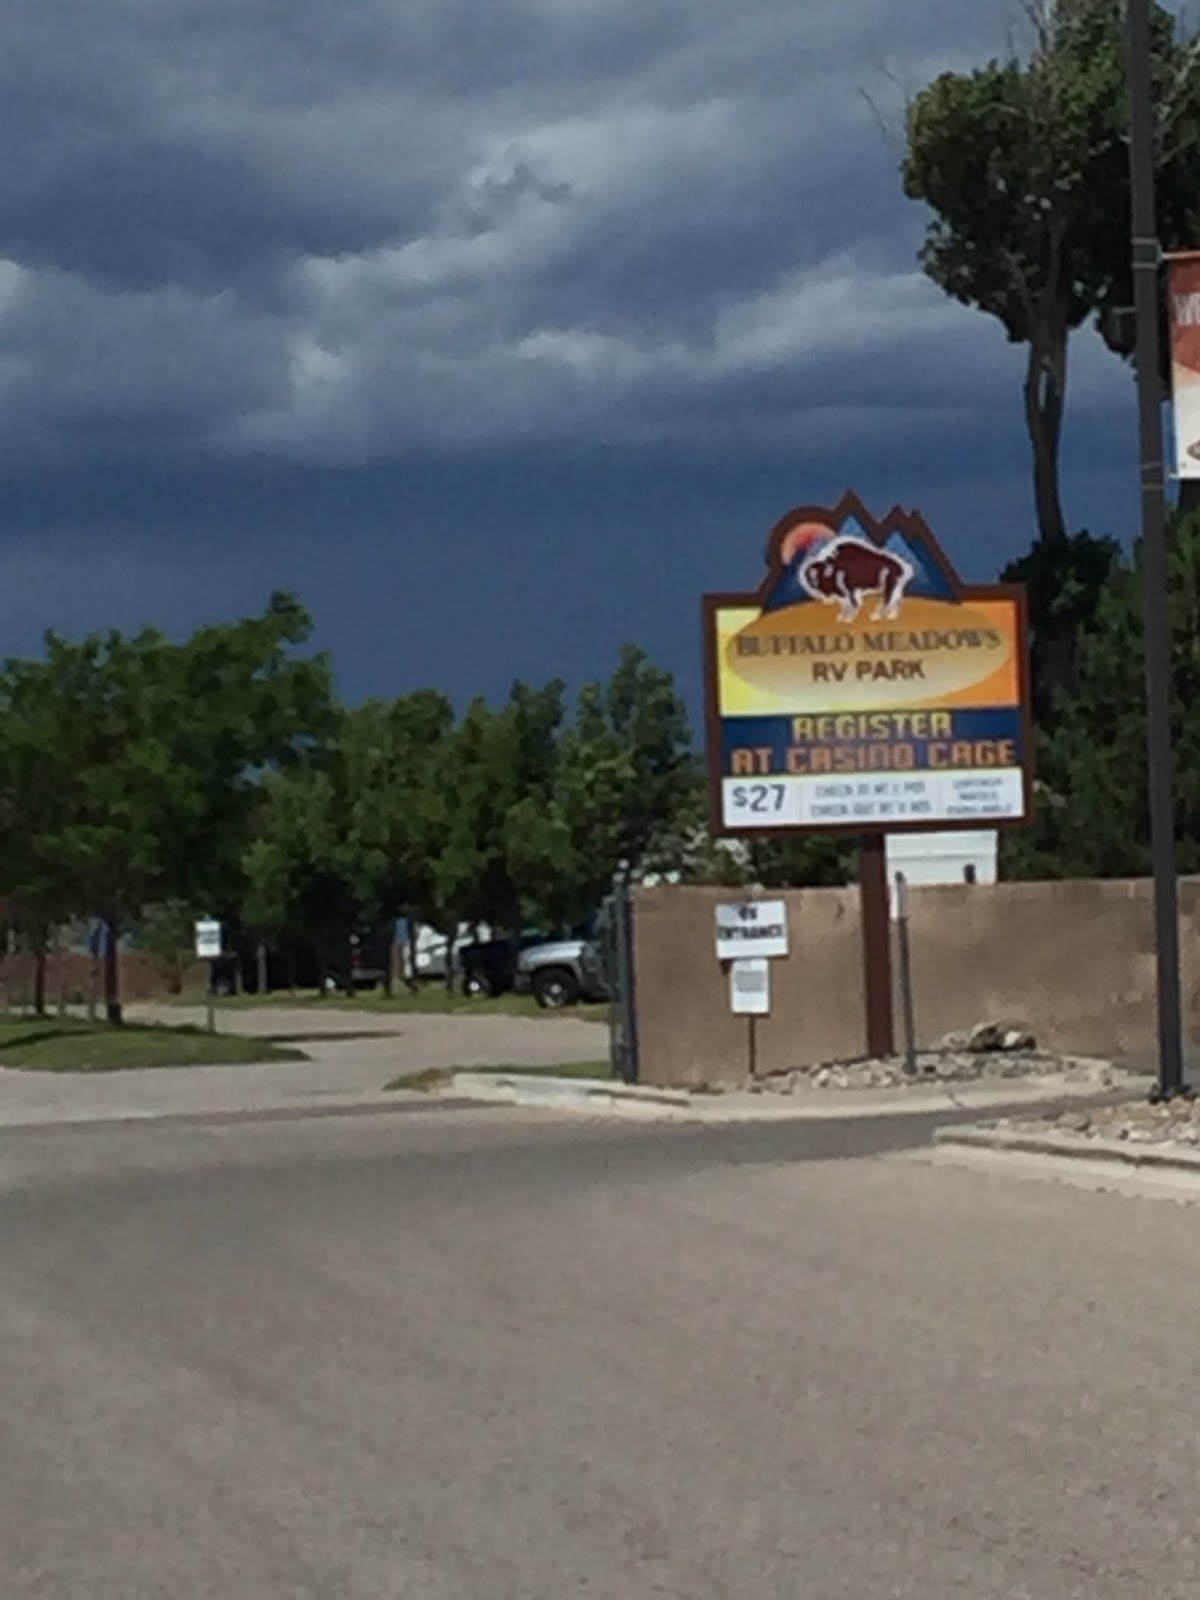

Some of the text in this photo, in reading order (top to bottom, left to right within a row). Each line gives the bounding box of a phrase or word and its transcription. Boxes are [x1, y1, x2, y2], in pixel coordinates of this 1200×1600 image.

[736, 627, 1001, 657] BUFFALO MEADOWS
[812, 658, 926, 682] RV PARK
[793, 712, 953, 742] REGISTER
[731, 738, 1016, 774] AT CASINO CAGE
[732, 784, 786, 813] $27
